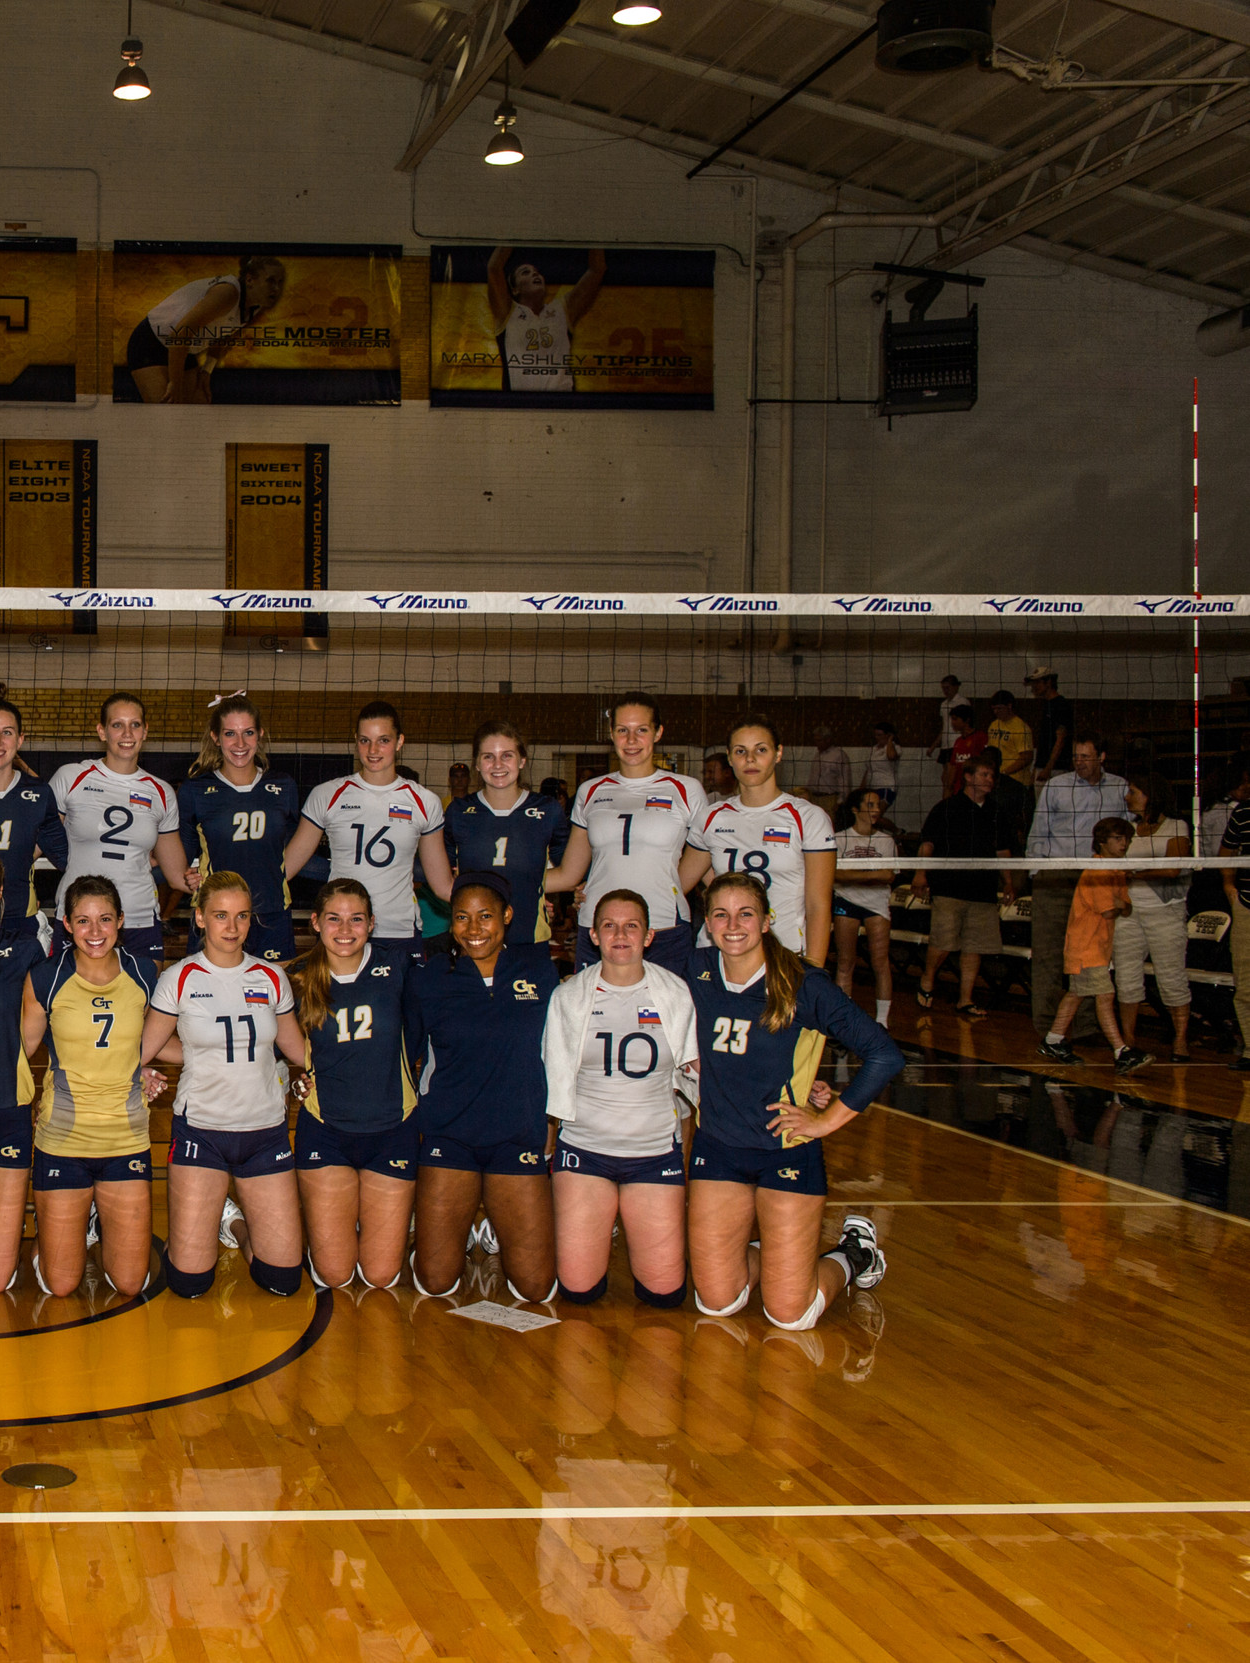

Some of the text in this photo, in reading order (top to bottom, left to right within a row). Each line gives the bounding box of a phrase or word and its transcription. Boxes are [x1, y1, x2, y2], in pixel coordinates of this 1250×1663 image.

[157, 325, 391, 340] LYNNETTE MOSTER
[525, 328, 554, 351] 25
[292, 340, 391, 349] ALL-AMERICAN
[442, 352, 693, 368] MARY ASHLEY TIPPINS
[9, 460, 71, 471] ELITE
[241, 463, 302, 472] SWEET
[9, 476, 70, 486] EIGHT
[9, 492, 71, 502] 2003
[241, 495, 302, 505] 2004
[82, 449, 91, 588] NCAA TOURNAME
[313, 452, 322, 590] NCAA TOURNAME
[20, 790, 40, 803] GT
[264, 783, 282, 795] GT
[524, 807, 545, 820] GT
[99, 805, 134, 846] 2
[232, 810, 267, 842] 20
[617, 813, 633, 856] 1
[350, 823, 396, 868] 16
[492, 836, 509, 867] 1
[723, 847, 771, 890] 18
[264, 949, 281, 961] GT
[371, 965, 391, 977] GT
[512, 979, 537, 996] GT
[91, 997, 113, 1010] GT
[92, 1013, 115, 1049] 7
[336, 1004, 372, 1044] 12
[215, 1014, 256, 1063] 11
[712, 1016, 751, 1056] 23
[595, 1031, 659, 1079] 10
[0, 1146, 21, 1158] GT
[185, 1140, 198, 1159] 11
[128, 1160, 146, 1174] GT
[561, 1150, 580, 1168] 10
[777, 1167, 801, 1180] GT
